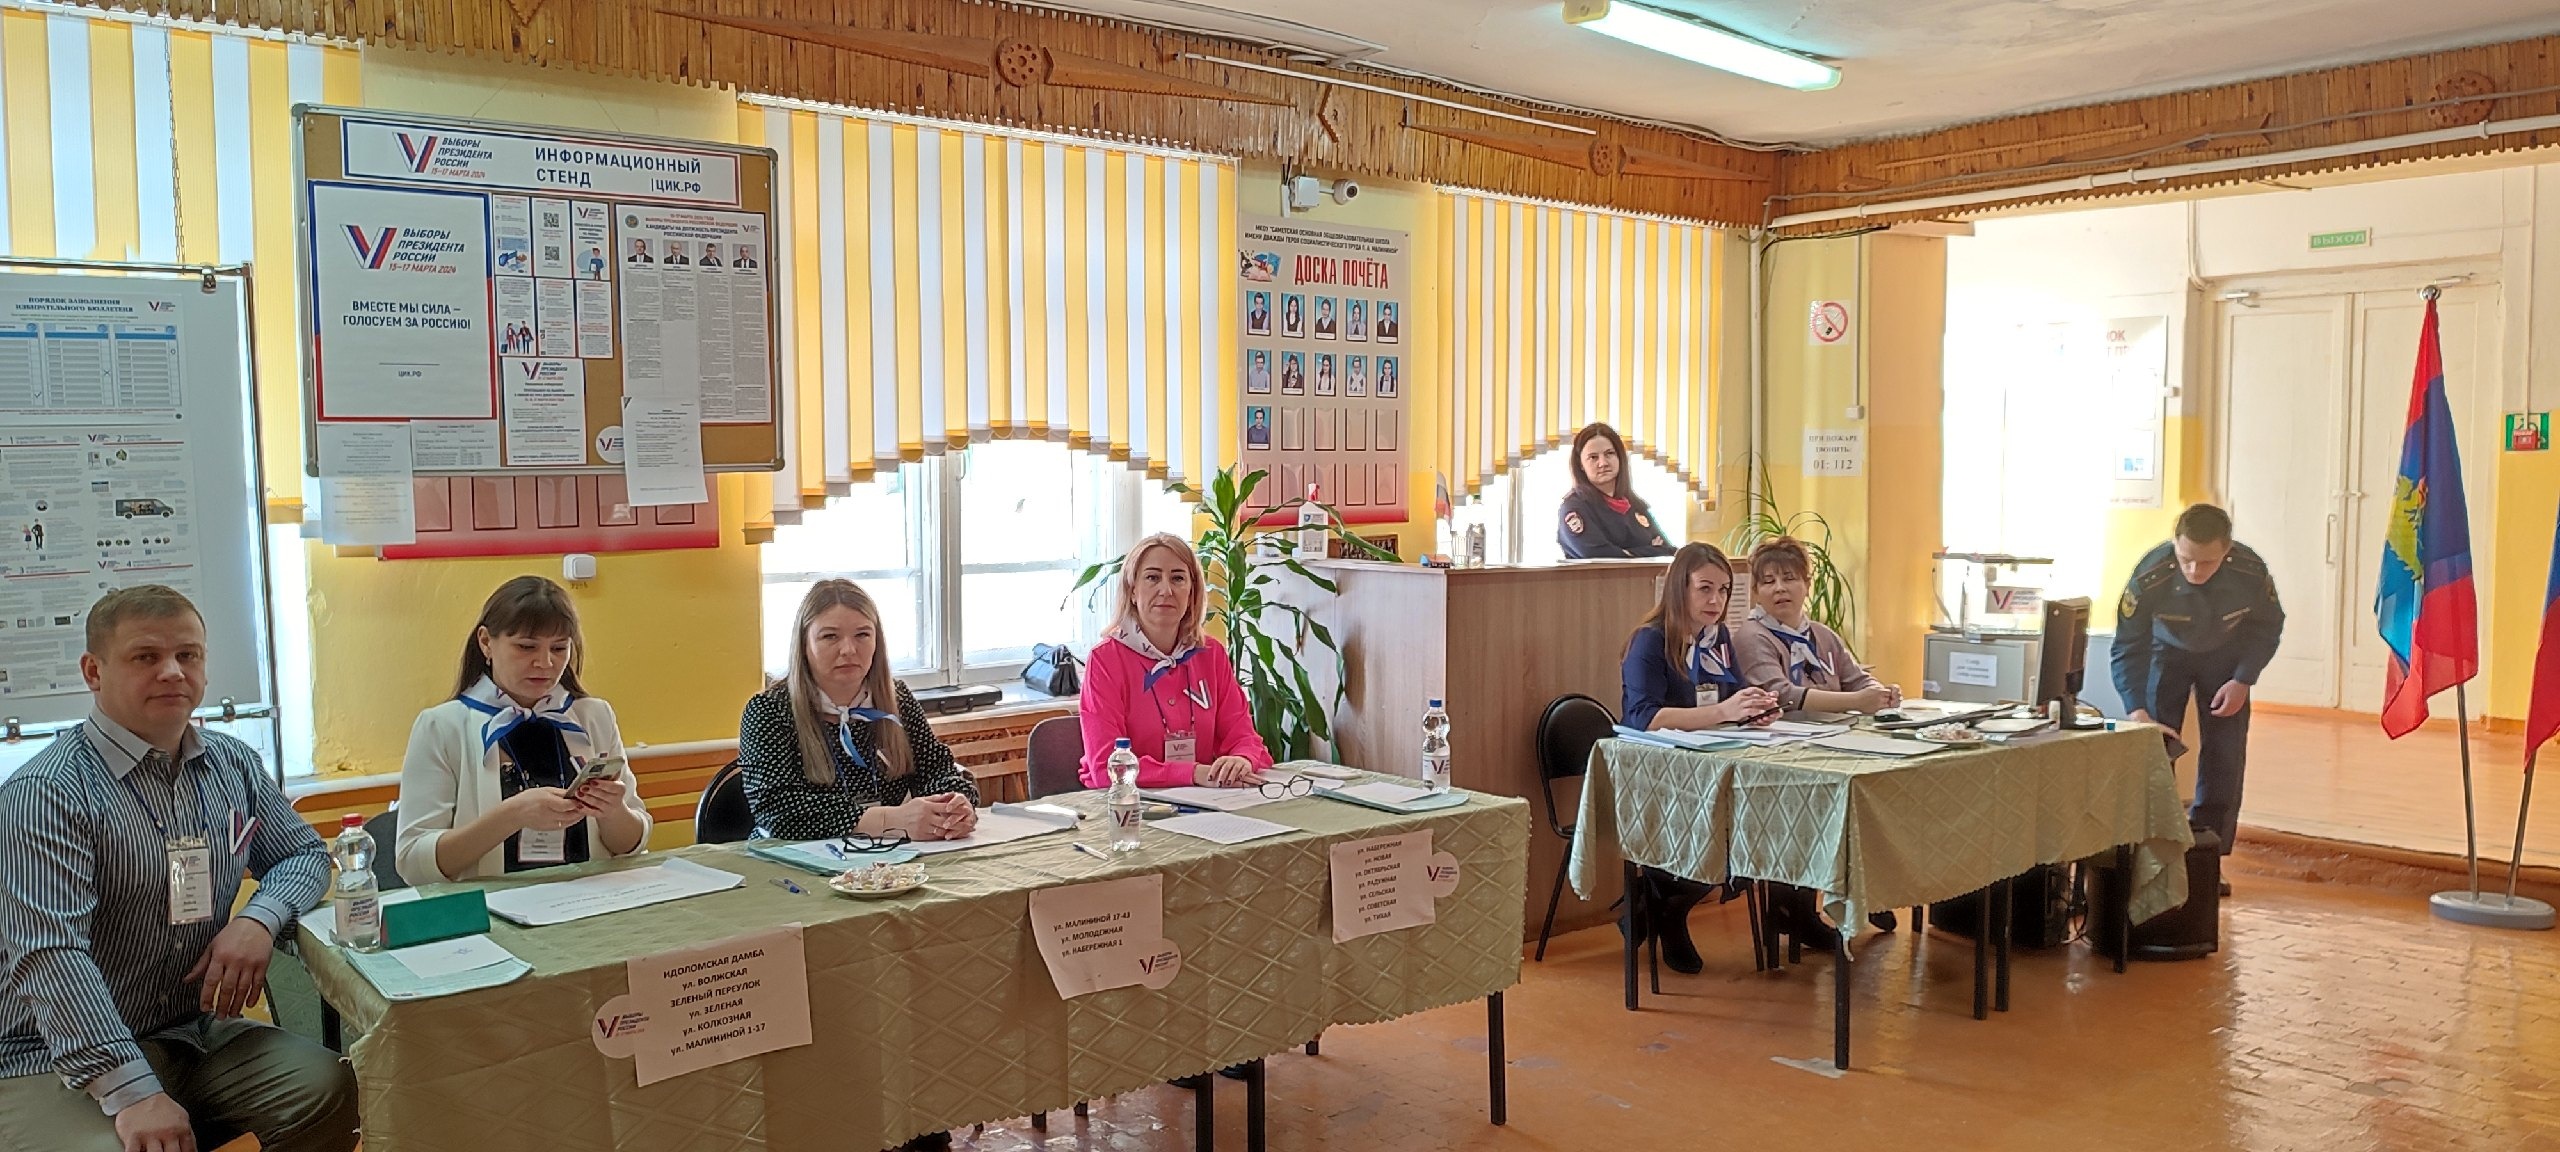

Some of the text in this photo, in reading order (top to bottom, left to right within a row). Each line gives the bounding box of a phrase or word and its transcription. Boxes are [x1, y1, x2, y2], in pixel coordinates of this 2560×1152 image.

[442, 137, 481, 148] ВЫБОРЫ
[438, 147, 493, 160] ПРЕЗИДЕНТА
[535, 147, 701, 174] ИНФОРМАЦИОННЫЙ
[435, 158, 469, 168] РОССИИ
[449, 168, 470, 177] МАРТА
[471, 170, 486, 179] 2024
[536, 168, 592, 188] СТЕНД
[403, 228, 451, 240] ВЫБОРЫ
[1299, 229, 1322, 238] ОСНОВНАЯ
[1323, 231, 1374, 244] ОБЩЕОБРАЗОВАТЕЛЬНАЯ
[1375, 237, 1390, 245] ШКОЛА
[2313, 233, 2365, 247] ВЫХОД
[398, 240, 465, 253] ПРЕЗИДЕНТА
[1263, 234, 1284, 242] ДВАЖДЫ
[1300, 238, 1348, 249] СОЦИАЛИСТИЧЕСКОГО
[392, 252, 437, 262] РОССИИ
[412, 264, 437, 273] МАРТА
[438, 265, 457, 274] 2024
[1295, 254, 1389, 289] ДОСКА ПОЧЁТА
[352, 300, 396, 312] ВМЕСТЕ
[400, 302, 419, 313] МЫ
[422, 303, 451, 314] СИЛА
[343, 315, 471, 330] ГОЛОСУЕМ ЗА РОССИЮ!
[1835, 459, 1853, 470] 112
[1366, 841, 1402, 852] НАБЕРЕЖНАЯ
[1373, 853, 1392, 861] НОВАЯ
[1363, 863, 1401, 875] ОКТЯБРЬСКАЯ
[1367, 876, 1397, 886] РАДУЖНАЯ
[1368, 887, 1396, 897] СЕЛЬСКАЯ
[1367, 899, 1397, 910] СОВЕТСКАЯ
[1053, 912, 1131, 932] ул. МАЛИНИНОЙ 17-43
[1373, 911, 1391, 921] ТИХАЯ
[1061, 926, 1123, 944] ул. МОЛОДЕЖНАЯ
[1062, 950, 1071, 958] ул.
[1072, 940, 1118, 955] НАБЕРЕЖНАЯ
[663, 948, 764, 979] ИДОЛОМСКАЯ ДАМБА
[682, 967, 748, 991] ул. ВОЛЖСКАЯ
[670, 979, 761, 1008] ЗЕЛЕНЫЙ ПЕРЕУЛОК
[688, 998, 743, 1020] ул. ЗЕЛЕНАЯ
[682, 1011, 752, 1036] ул. КОЛХОЗНАЯ
[670, 1022, 766, 1056] ул. МАЛИНИНОЙ 1-17
